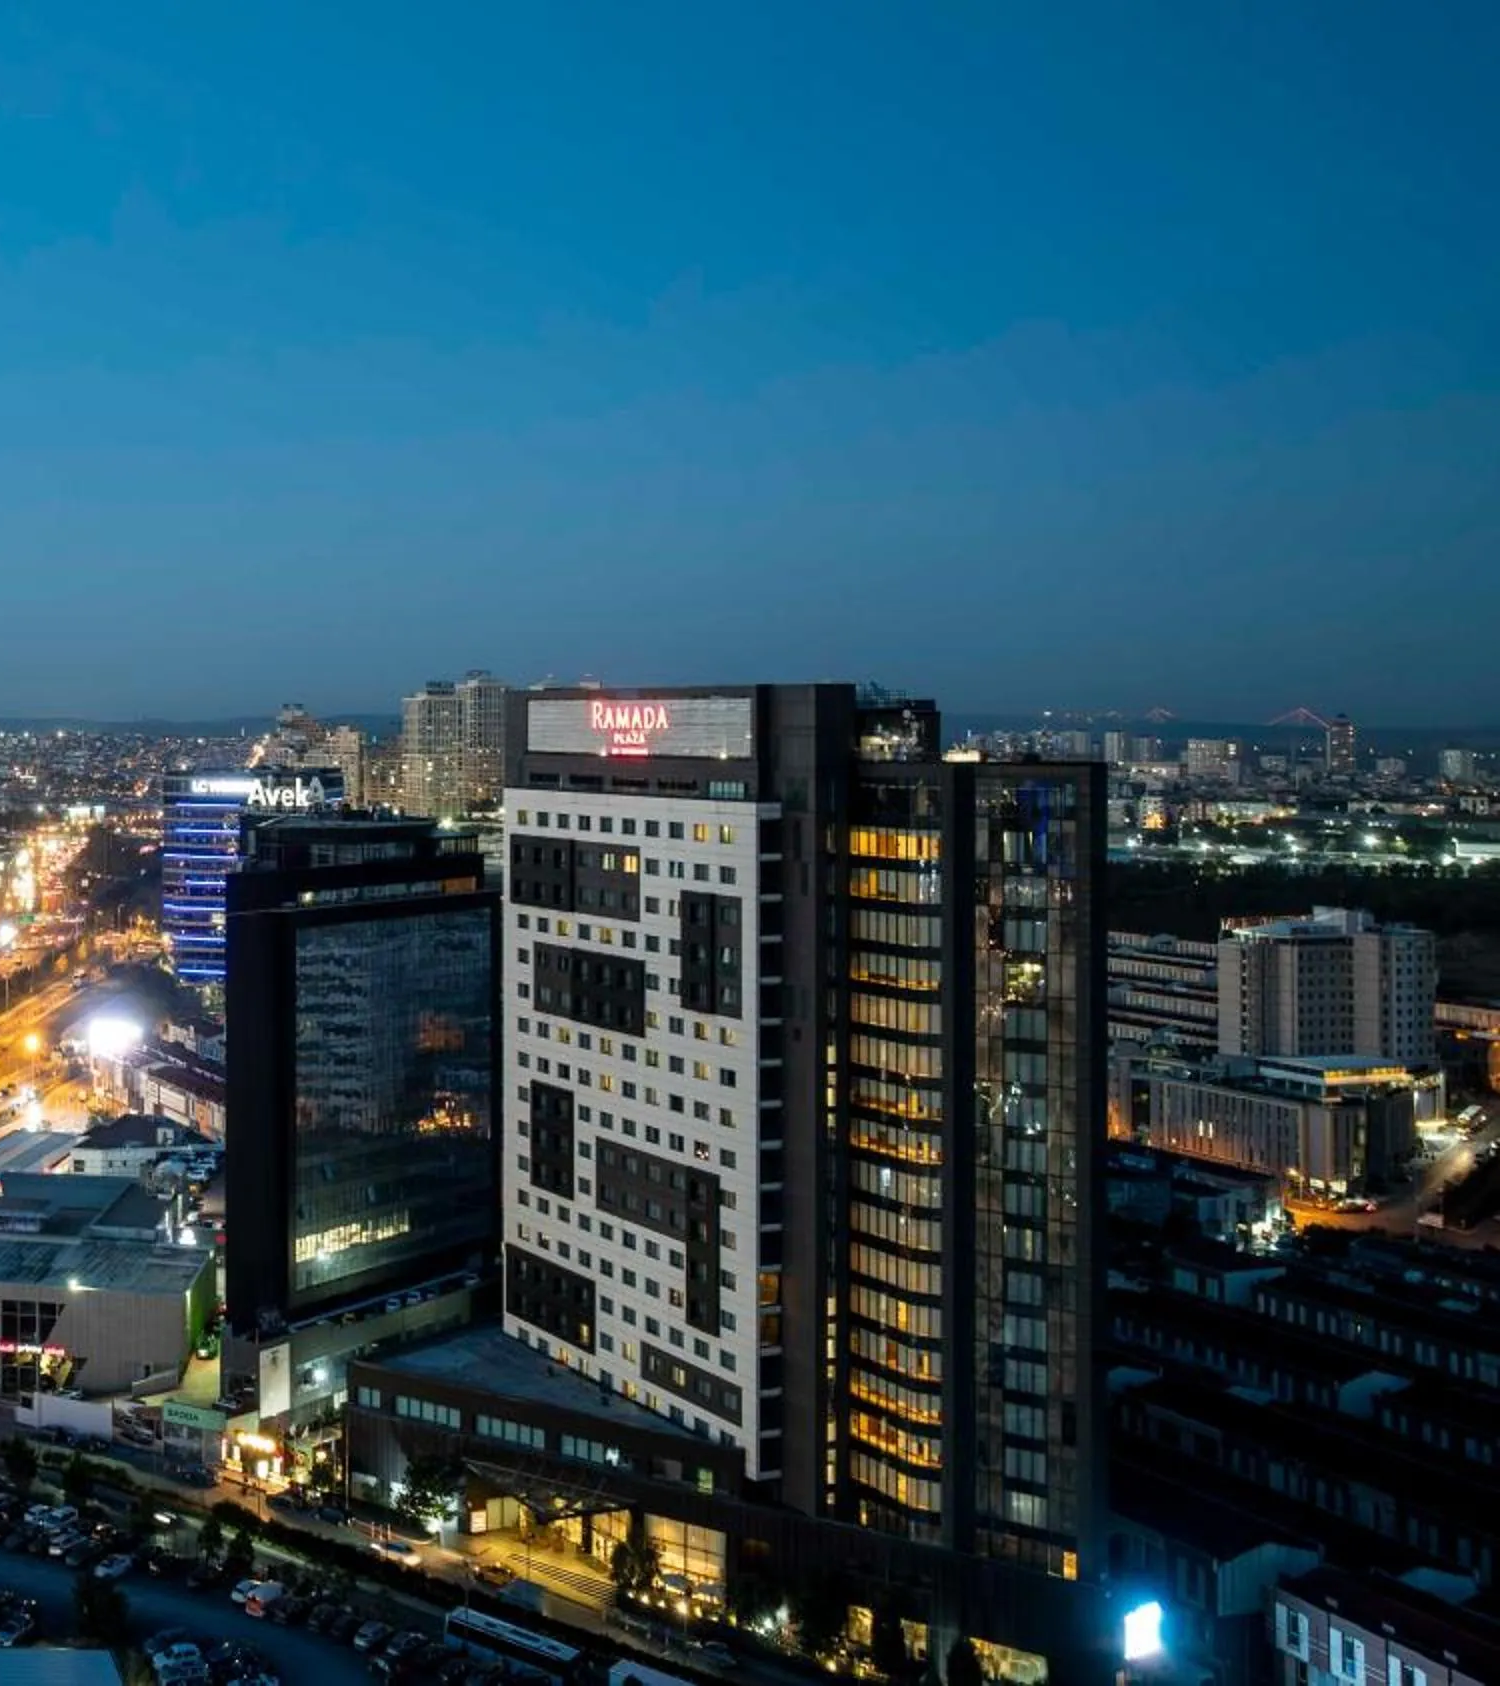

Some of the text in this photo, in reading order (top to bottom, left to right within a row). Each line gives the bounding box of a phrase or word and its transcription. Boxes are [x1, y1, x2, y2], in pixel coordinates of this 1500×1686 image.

[592, 701, 669, 729] RAMADA
[613, 732, 646, 744] PLAZA
[247, 777, 310, 807] Avek
